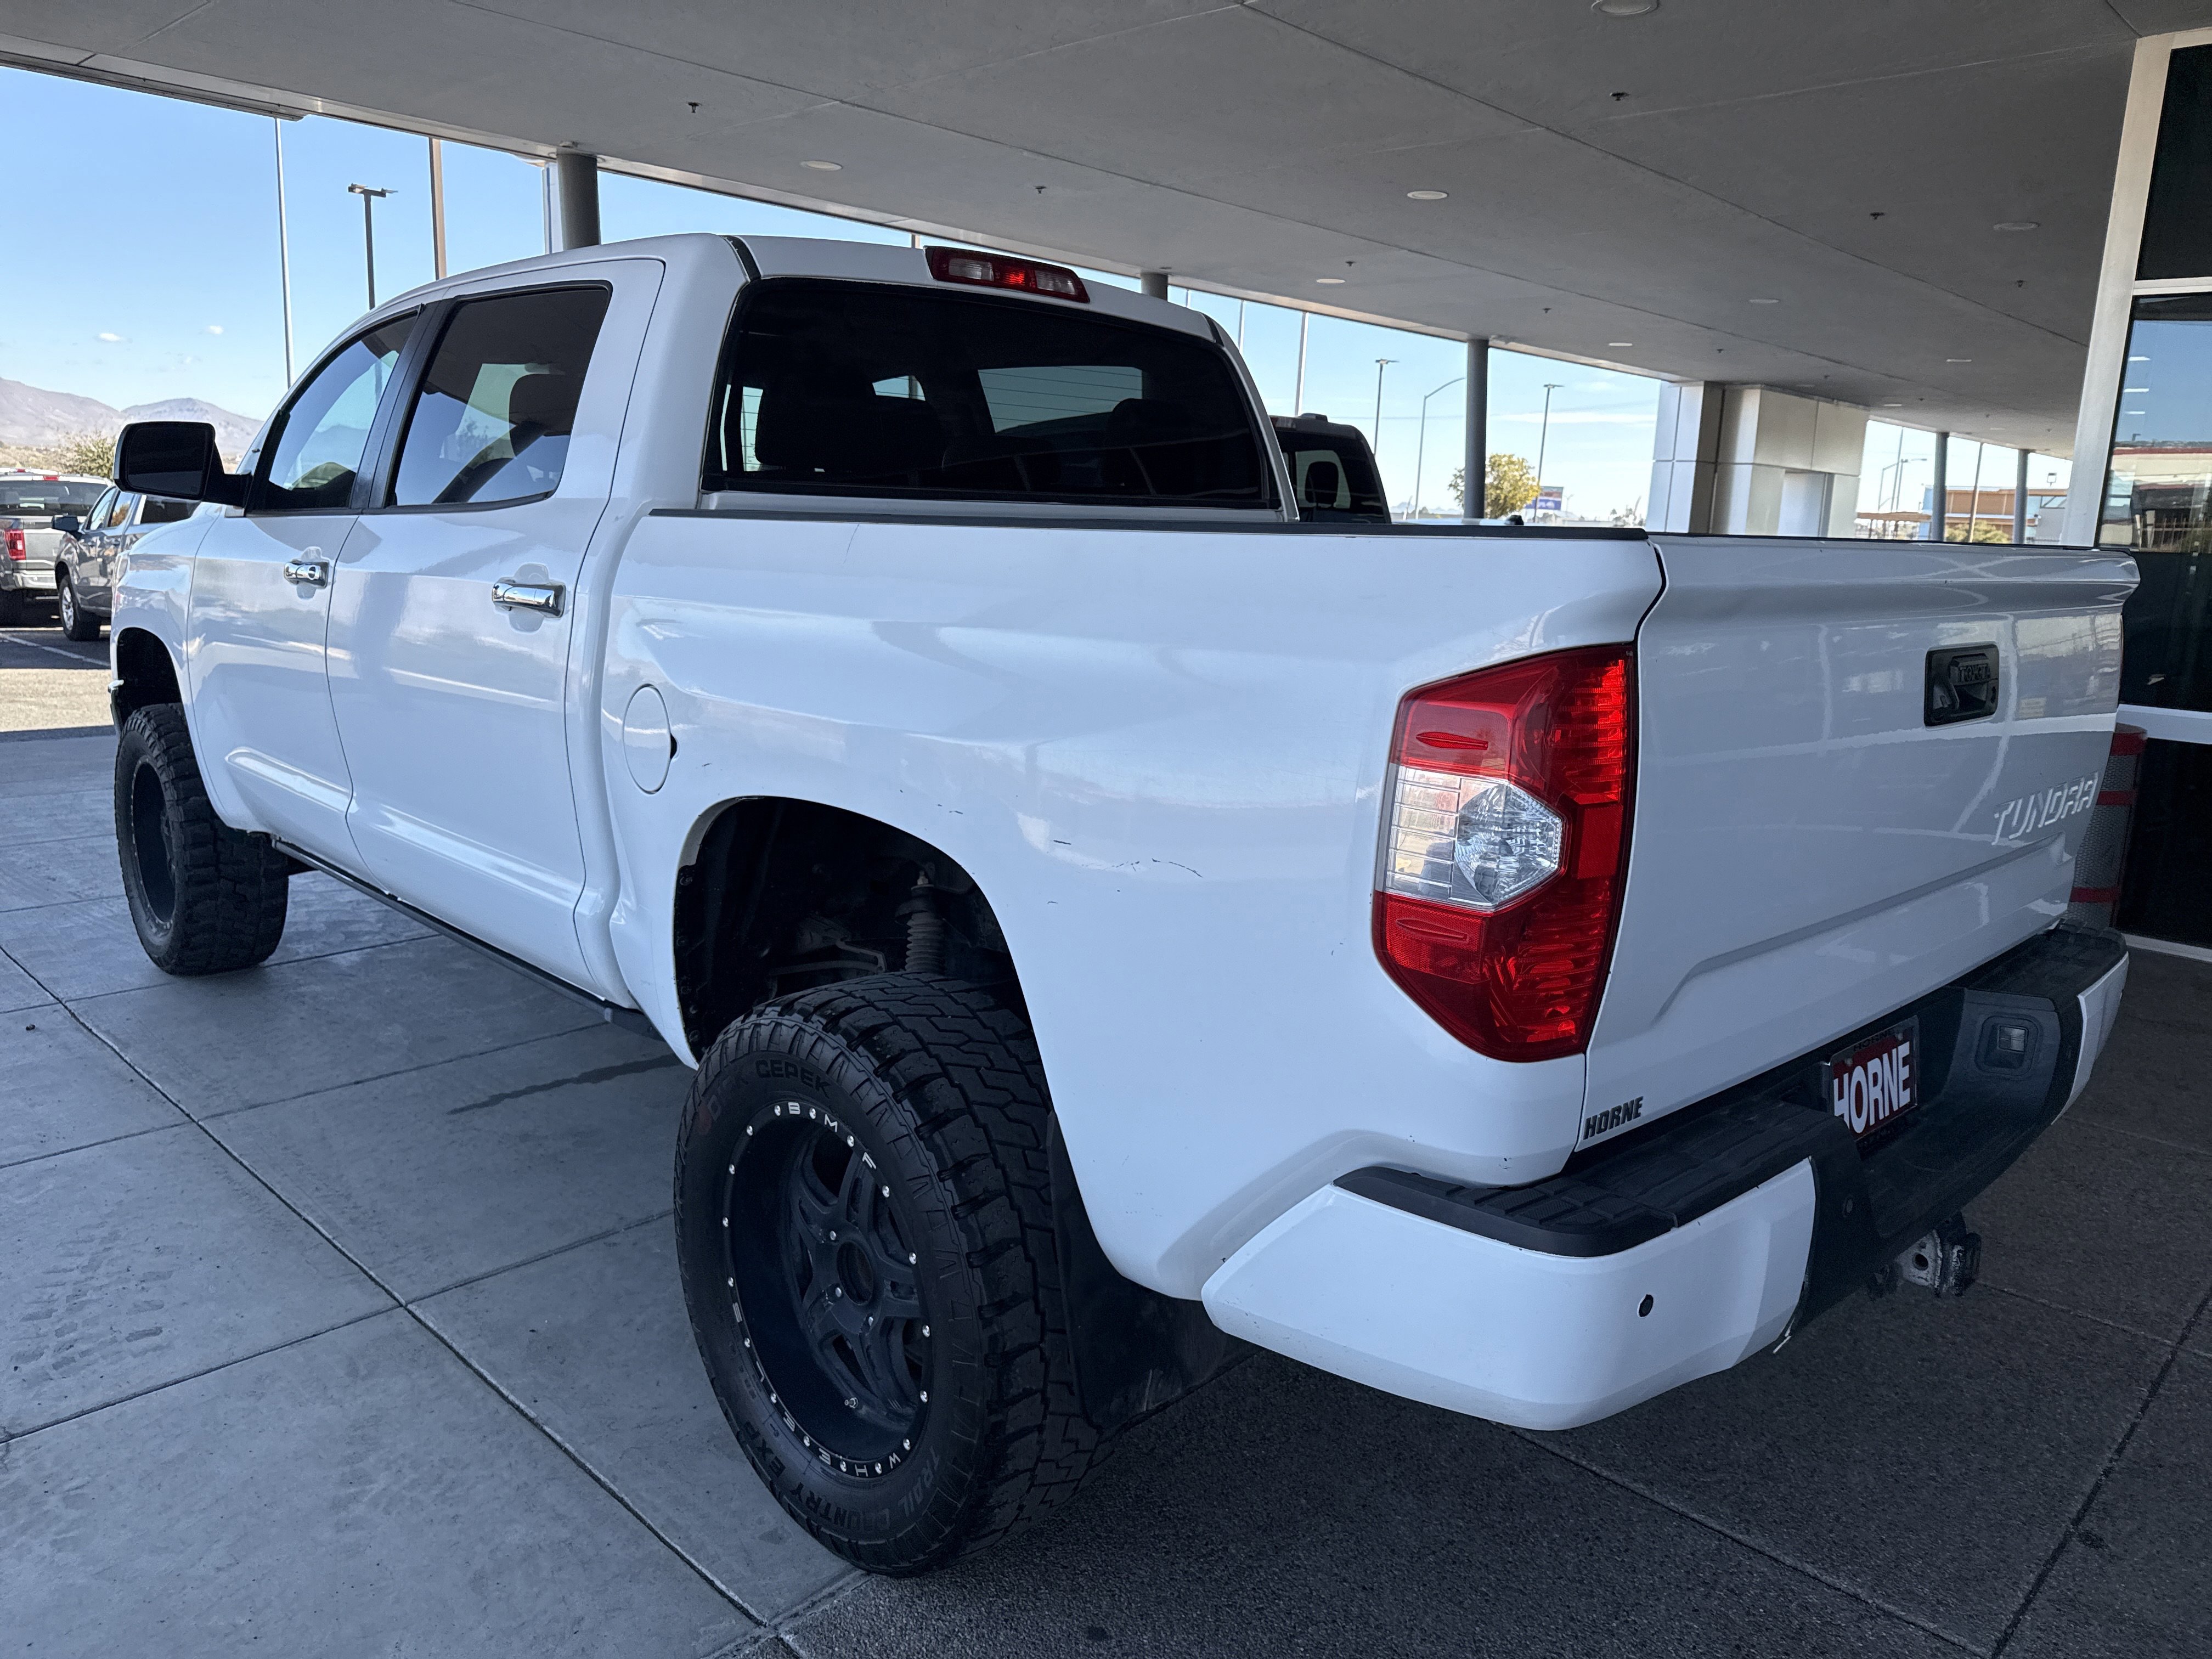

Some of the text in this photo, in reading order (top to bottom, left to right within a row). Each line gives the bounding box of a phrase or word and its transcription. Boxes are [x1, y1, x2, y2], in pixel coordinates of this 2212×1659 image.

[1991, 771, 2099, 845] TUNDRA
[755, 1059, 830, 1098] CEPEK
[1833, 1041, 1911, 1133] HORNE
[1583, 1096, 1644, 1141] HORNE
